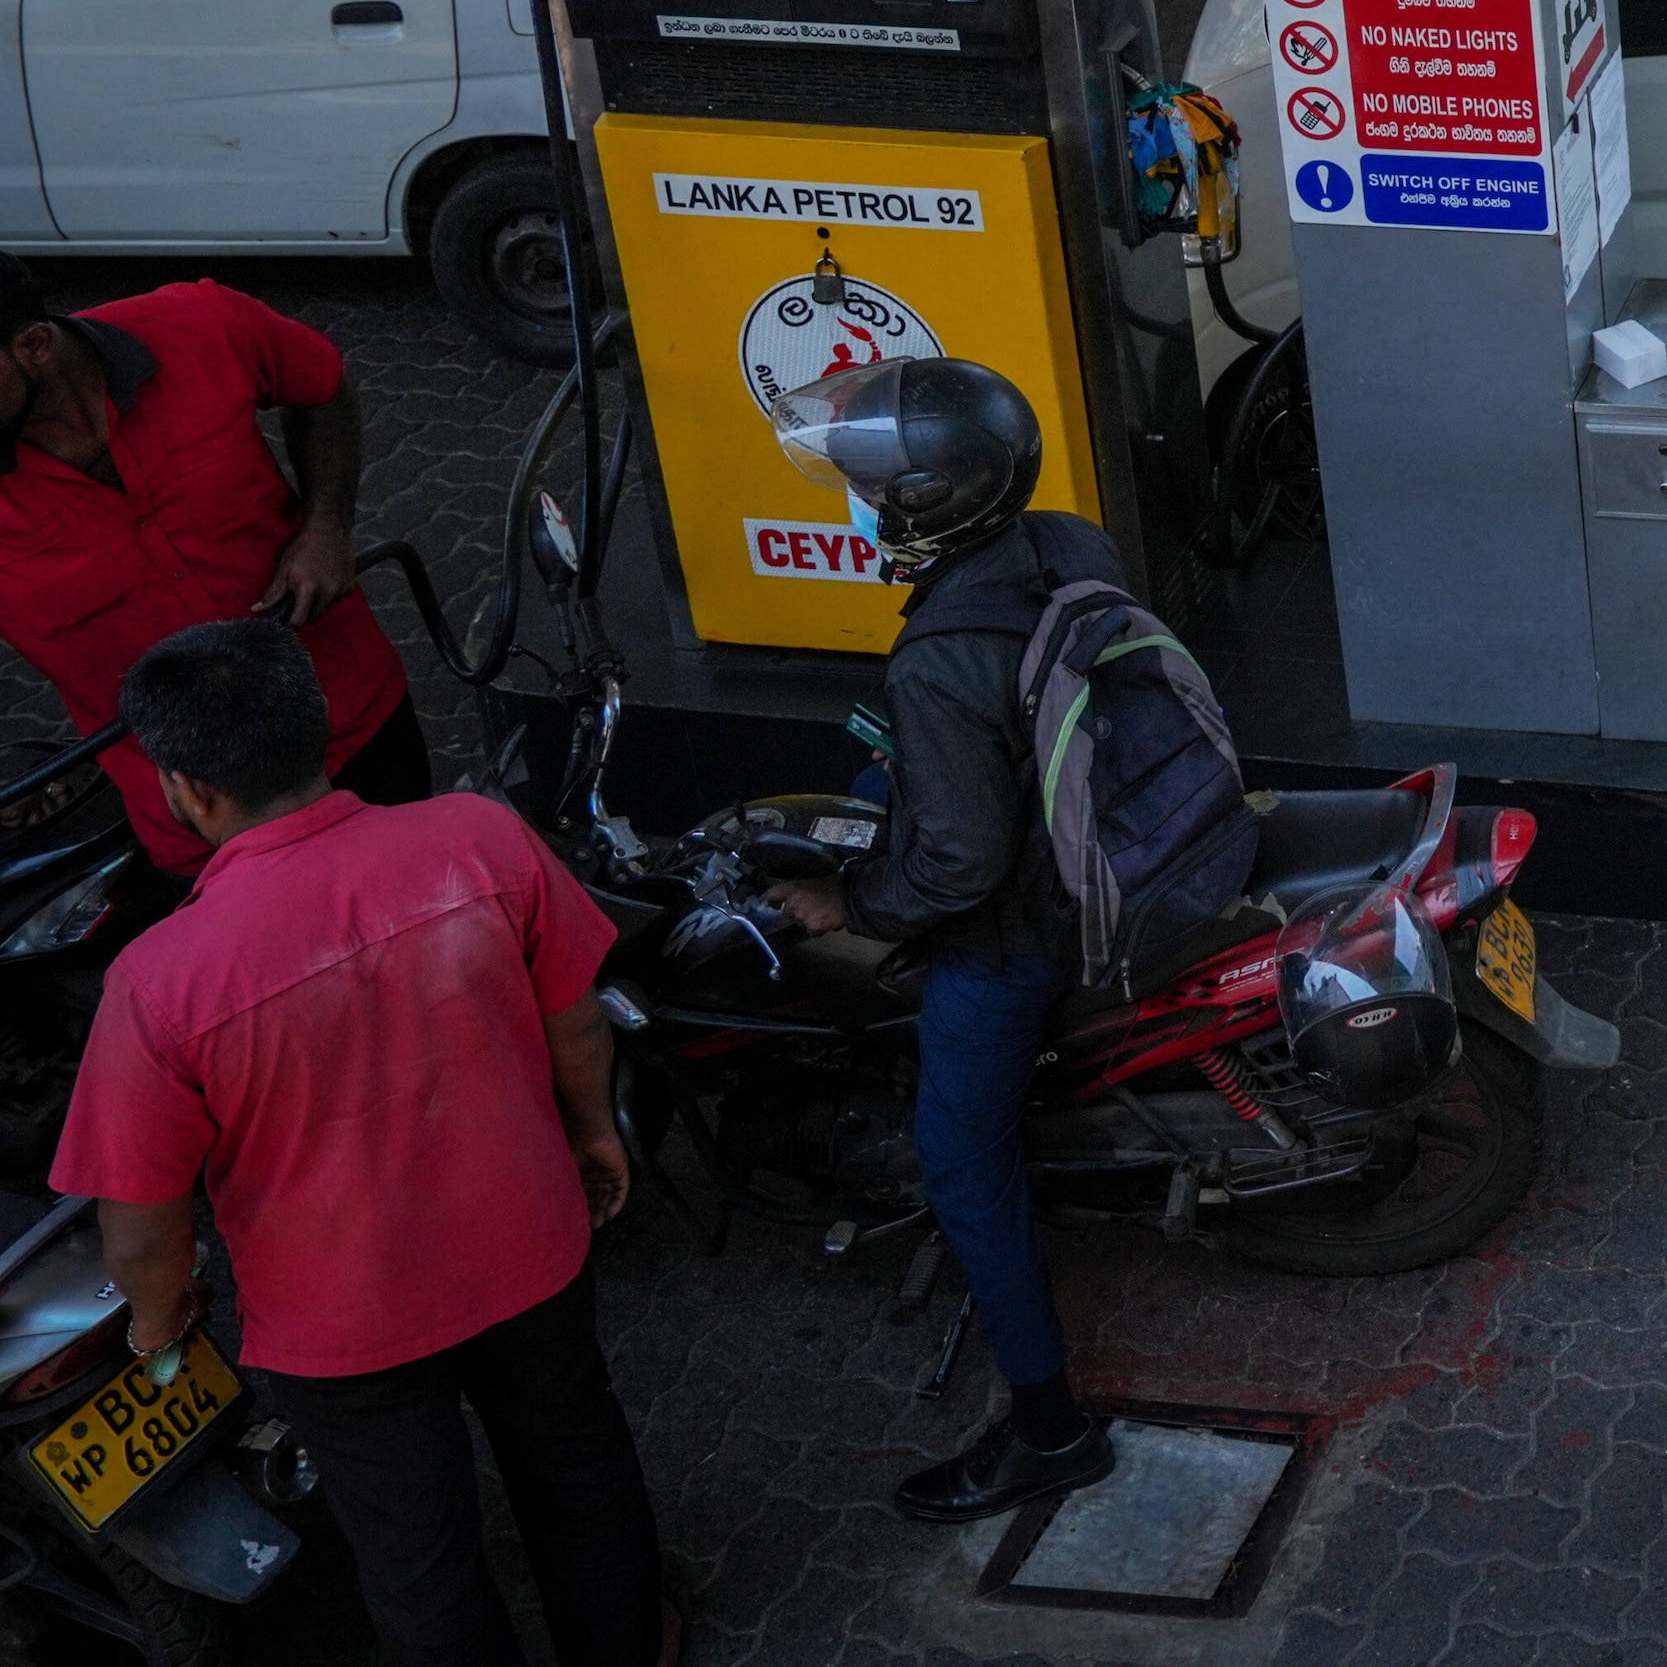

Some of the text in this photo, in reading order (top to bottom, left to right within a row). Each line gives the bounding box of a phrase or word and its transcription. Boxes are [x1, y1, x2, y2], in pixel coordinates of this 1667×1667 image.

[1361, 25, 1519, 52] NO NAKED LIGHTS
[1389, 56, 1410, 75] ගිනි
[1457, 60, 1496, 79] තහනම්
[1362, 93, 1534, 120] NO MOBILE PHONES
[1496, 127, 1537, 145] තහනම්
[1368, 173, 1540, 194] SWITCH OFF ENGINE
[664, 180, 975, 226] LANKA PETROL 92
[93, 1348, 191, 1437] BC
[59, 1378, 221, 1495] WP 6804
